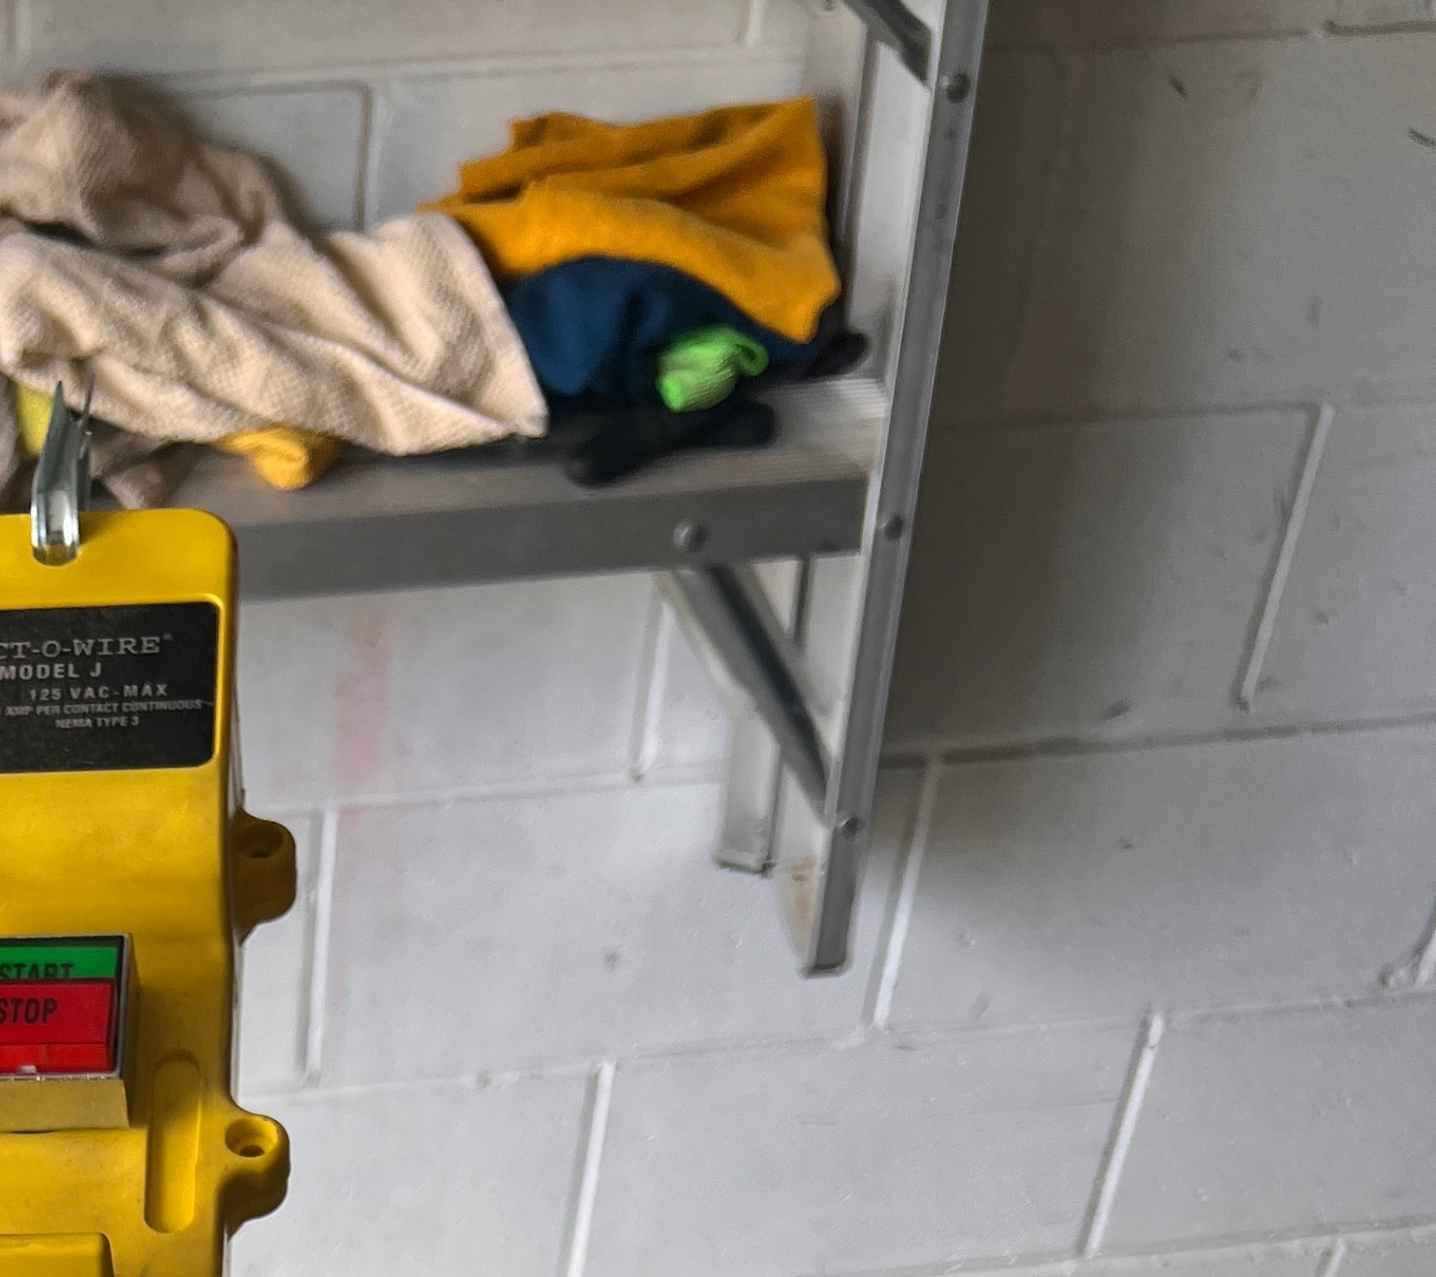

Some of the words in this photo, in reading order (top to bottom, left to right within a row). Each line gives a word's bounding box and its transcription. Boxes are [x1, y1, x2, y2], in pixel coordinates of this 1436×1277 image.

[89, 662, 102, 677] J
[30, 688, 62, 701] 125
[35, 705, 61, 716] PER
[64, 702, 119, 715] CONTACT
[122, 699, 202, 712] CONTINUOUS
[55, 718, 93, 729] NEMA
[96, 716, 127, 727] TYPE
